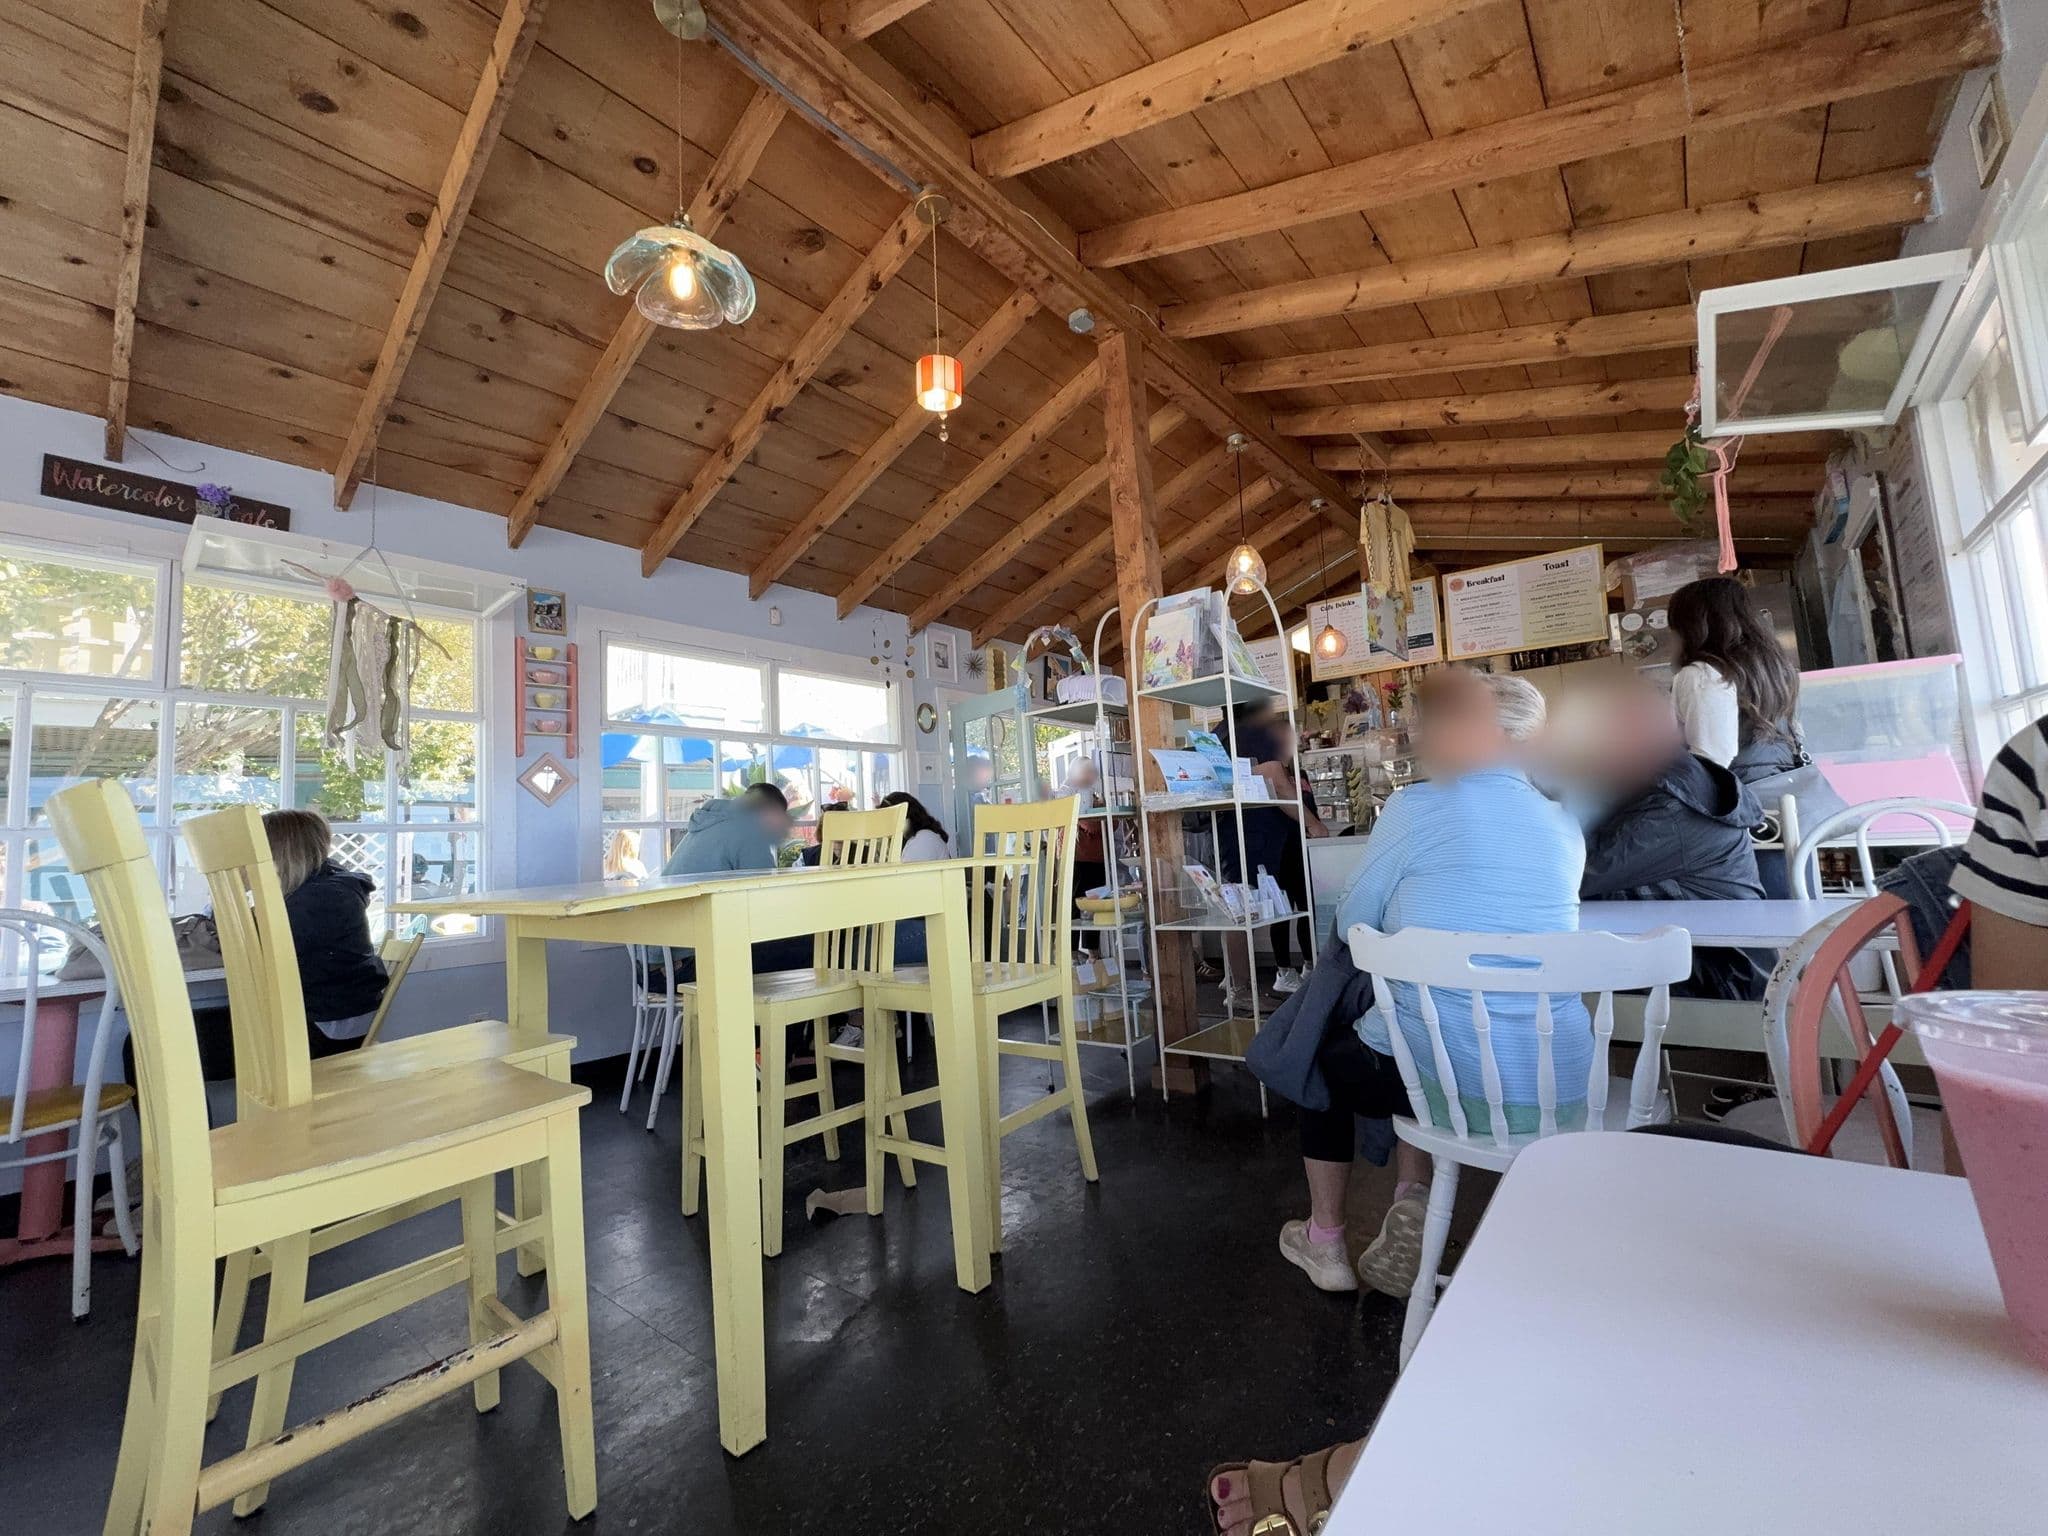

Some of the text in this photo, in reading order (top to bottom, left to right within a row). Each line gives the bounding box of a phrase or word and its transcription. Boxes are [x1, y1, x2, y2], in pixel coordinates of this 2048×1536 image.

[52, 461, 190, 513] Watercolor
[1542, 559, 1570, 571] Toast
[1466, 574, 1506, 588] Breakfast
